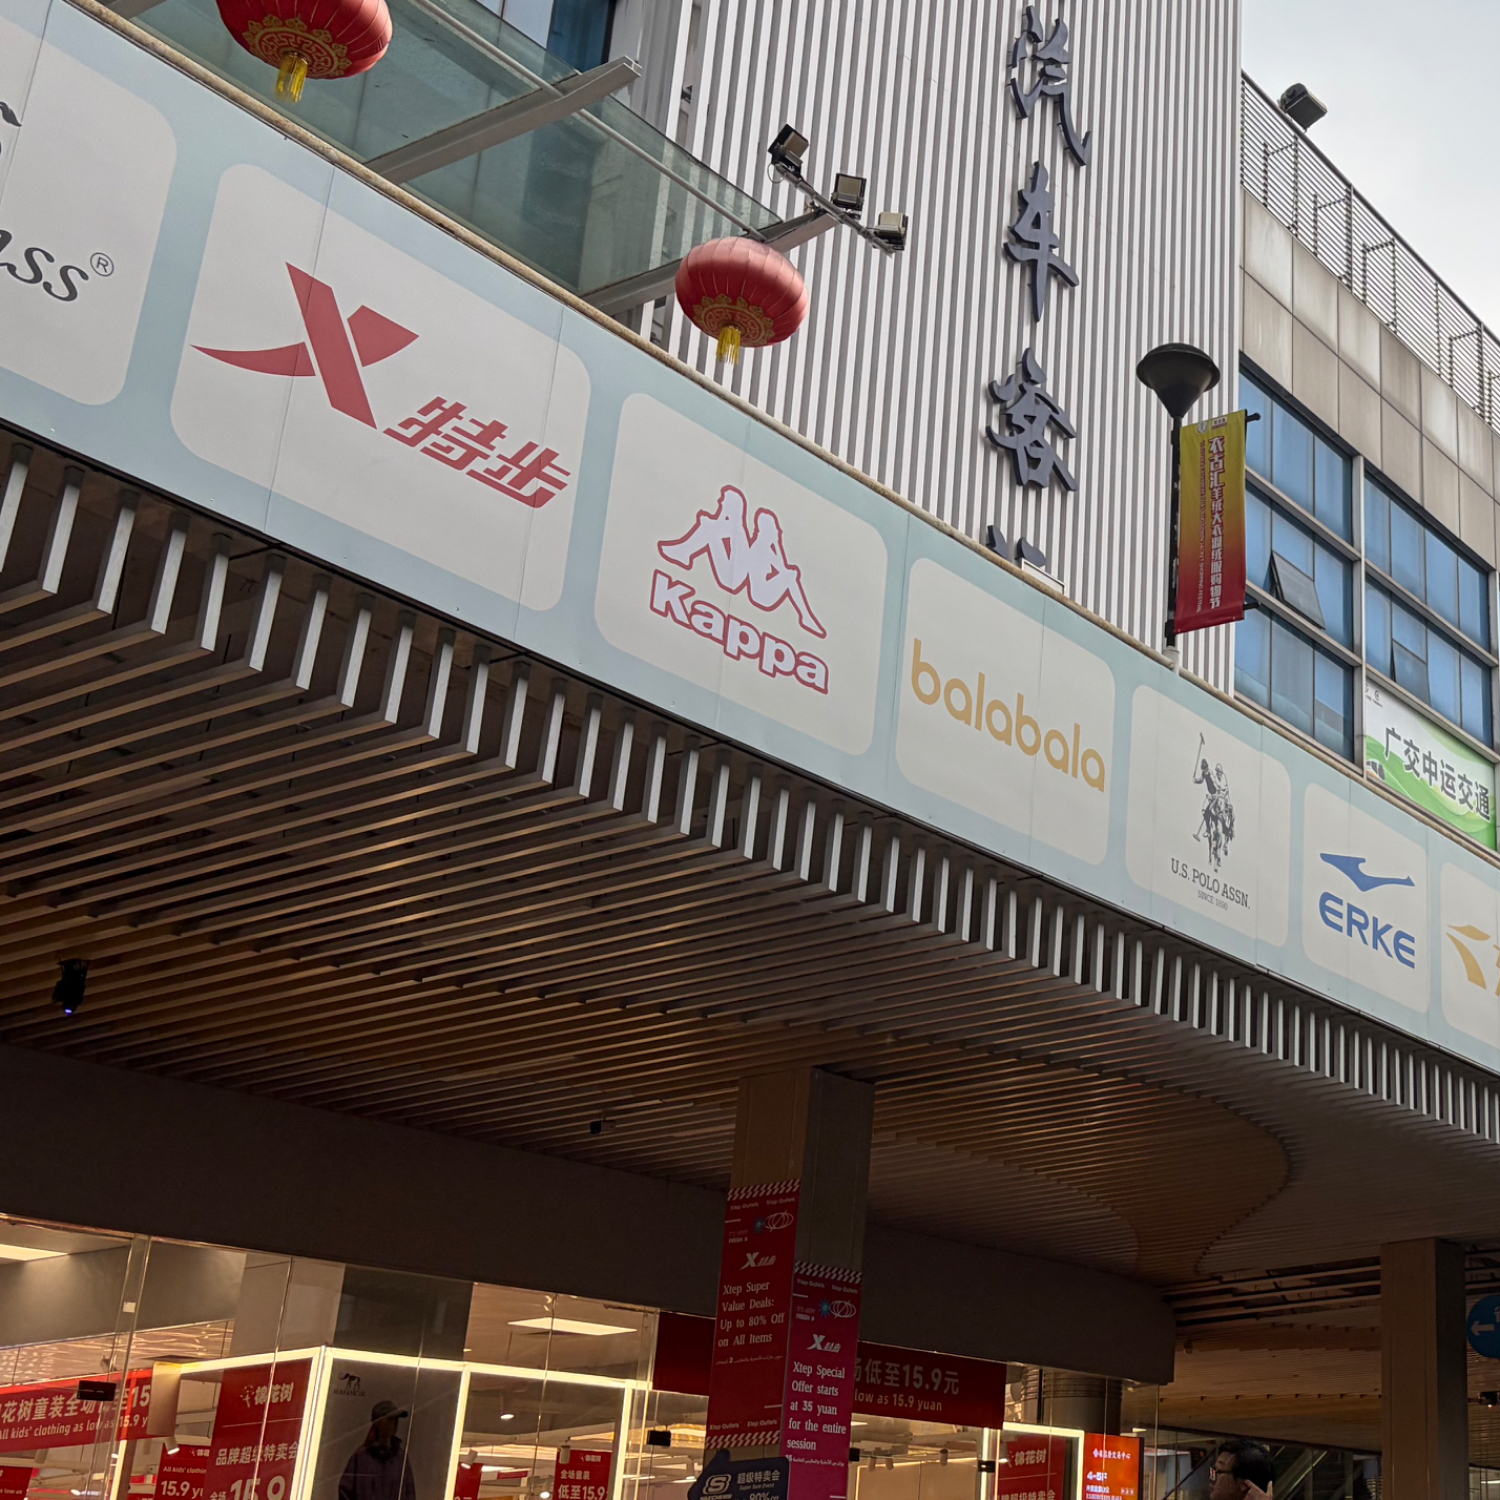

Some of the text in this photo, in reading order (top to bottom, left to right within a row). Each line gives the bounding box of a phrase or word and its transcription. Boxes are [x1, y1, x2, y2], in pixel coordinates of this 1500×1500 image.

[986, 5, 1091, 567] 汽车客
[383, 396, 571, 508] 特步
[650, 569, 828, 694] Kappa
[912, 638, 1105, 792] balabala
[1385, 727, 1490, 821] 广交中运交通
[1171, 857, 1251, 910] U.S. POLO ASSN.
[1197, 890, 1215, 905] SINCE
[1319, 891, 1415, 969] ERKE
[722, 1281, 770, 1296] Xtep Super
[721, 1297, 775, 1312] Value Deals:
[719, 1319, 733, 1332] Up
[736, 1319, 745, 1328] to
[770, 1312, 786, 1324] Off
[717, 1333, 773, 1347] on All Items
[793, 1361, 846, 1379] Xtep Special
[791, 1380, 839, 1396] Offer starts
[789, 1400, 838, 1416] at 35 yuan
[854, 1388, 942, 1412] low as 15.9 yuan
[34, 1421, 71, 1437] clothing
[73, 1422, 84, 1433] as
[788, 1417, 847, 1434] for the entire
[786, 1439, 817, 1451] session
[161, 1480, 190, 1497] 15.9
[558, 1483, 608, 1500] 低至15.9
